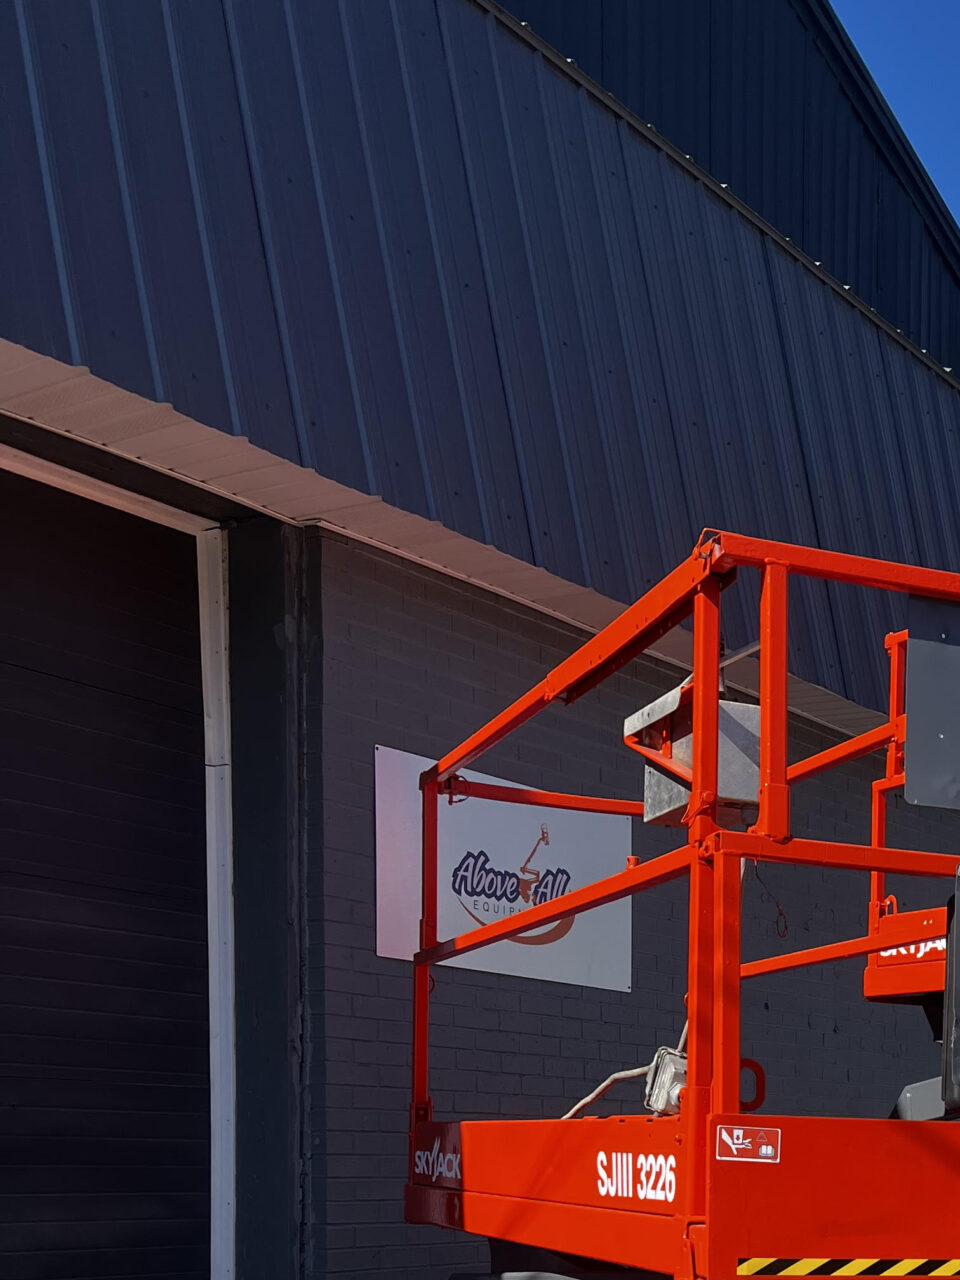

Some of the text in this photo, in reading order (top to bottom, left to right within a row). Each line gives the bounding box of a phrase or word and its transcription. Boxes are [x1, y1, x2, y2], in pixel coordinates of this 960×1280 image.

[452, 851, 571, 905] Above All
[473, 900, 523, 916] EQUIP
[414, 1136, 462, 1182] SKYJACK
[637, 1154, 676, 1202] 3226
